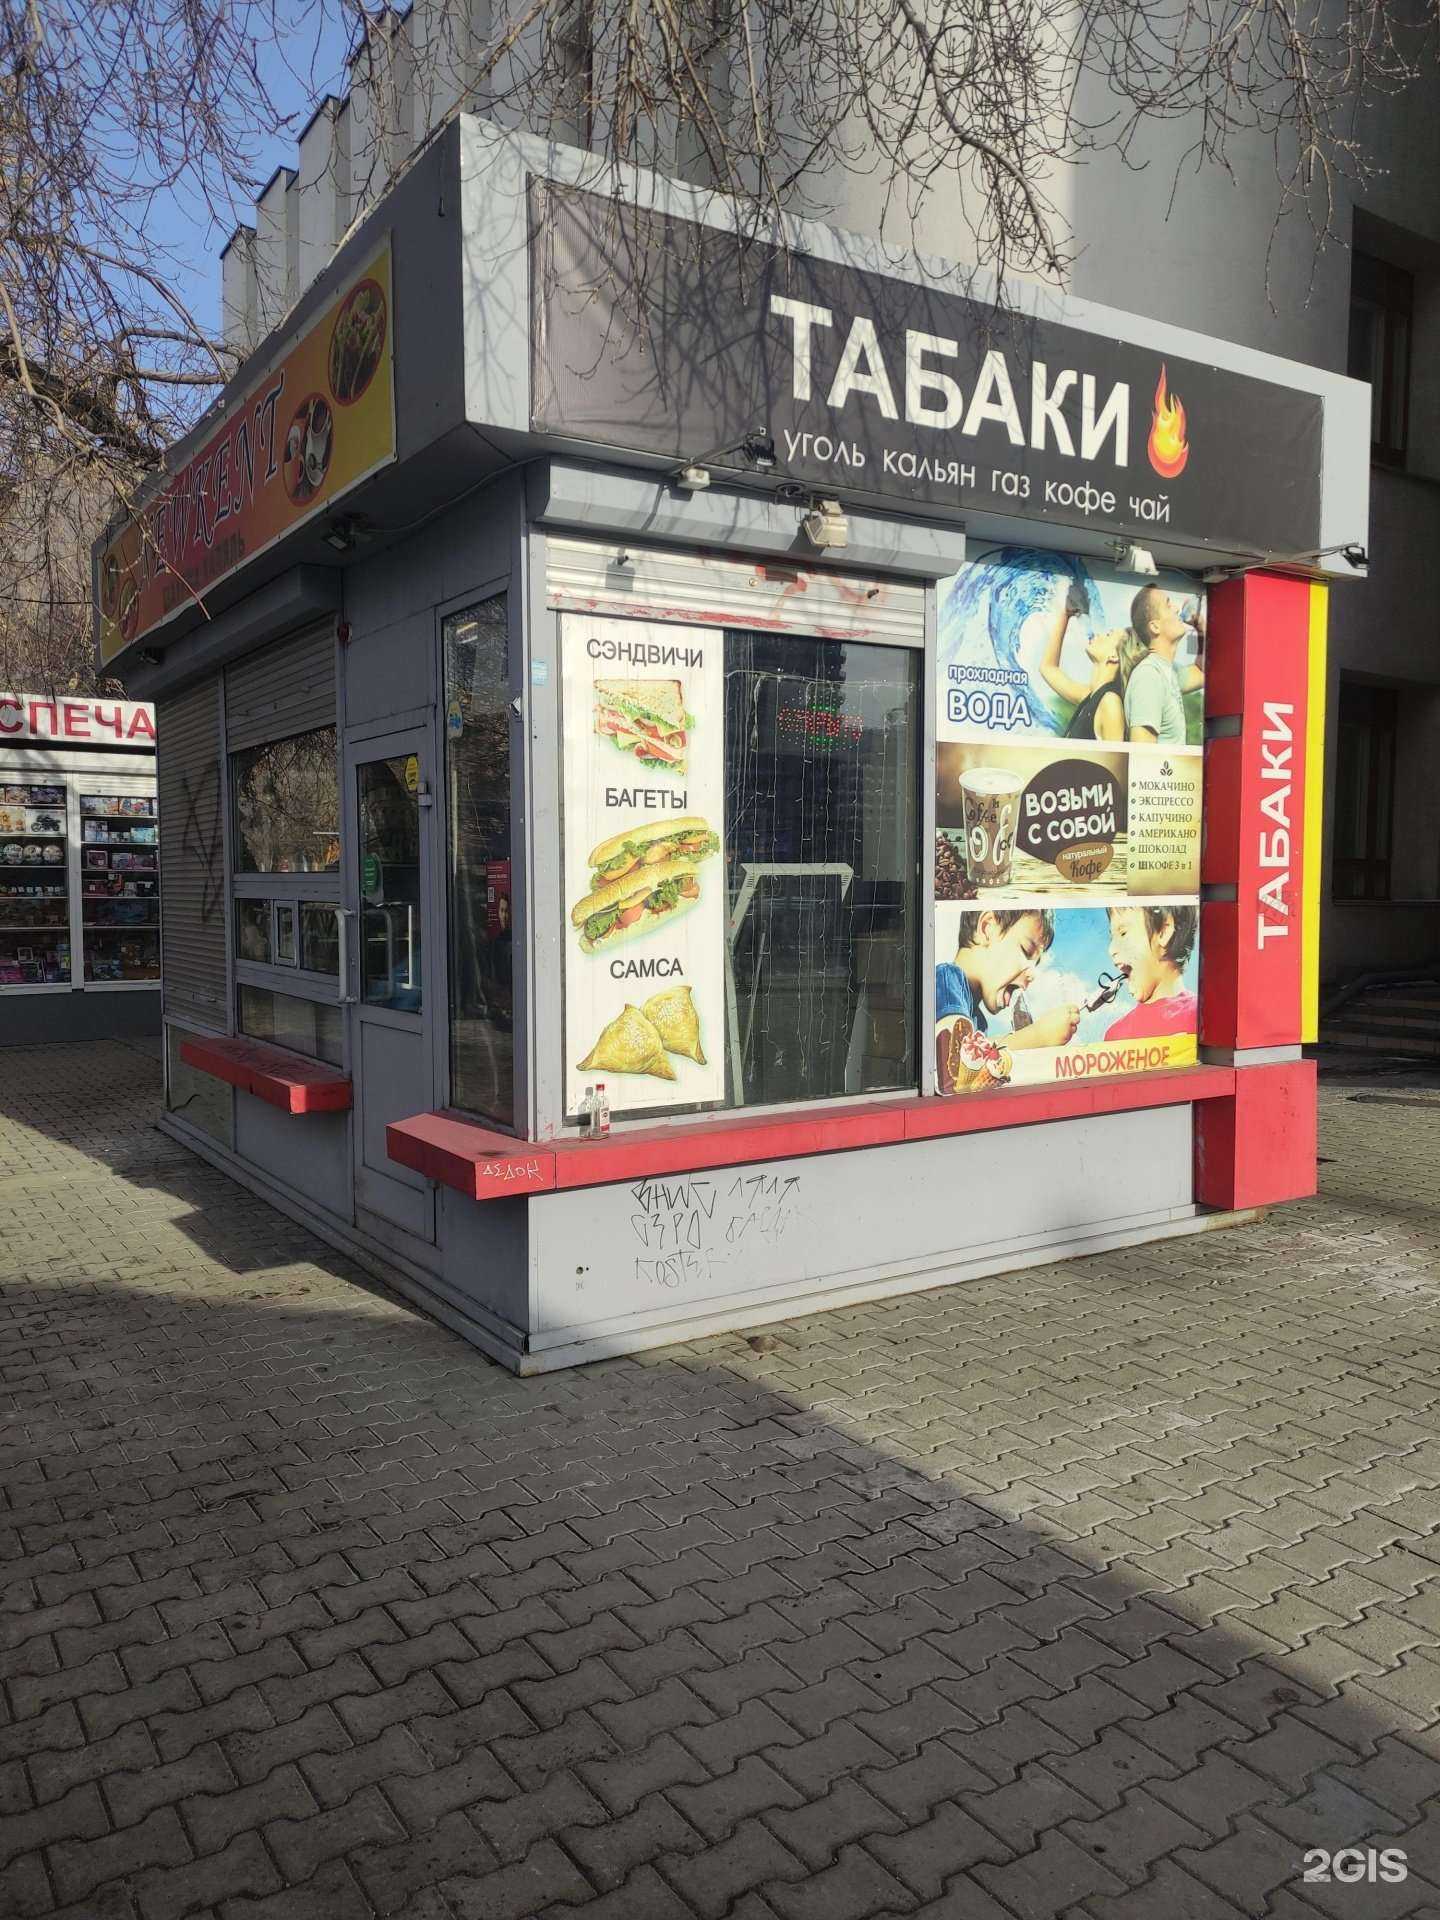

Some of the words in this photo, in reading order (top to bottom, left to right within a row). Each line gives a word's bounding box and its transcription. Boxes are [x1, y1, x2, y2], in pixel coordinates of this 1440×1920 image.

[770, 294, 1130, 468] ТАБАКИ
[783, 429, 866, 467] уголь
[882, 447, 976, 488] кальян
[991, 469, 1031, 498] газ
[1045, 480, 1116, 515] кофе
[1129, 494, 1172, 523] чай
[586, 638, 703, 668] СЭНДВИЧИ
[948, 664, 1029, 686] прохладная
[948, 688, 1032, 730] ВОДА
[605, 787, 688, 810] БАГЕТЫ
[1138, 780, 1195, 792] МОКАЧИНО
[1025, 782, 1114, 817] ВОЗЬМИ
[1138, 796, 1194, 807] ЭКСПРЕССО
[1028, 823, 1042, 845] С
[1046, 806, 1116, 842] СОБОЙ
[1138, 813, 1193, 824] КАПУЧИНО
[1257, 701, 1294, 950] ТАБАКИ
[1138, 828, 1197, 839] АМЕРИКАНО
[1138, 844, 1187, 854] ШОКОЛАД
[609, 957, 684, 980] САМСА
[1055, 1045, 1170, 1078] МОРОЖЕНОЕ
